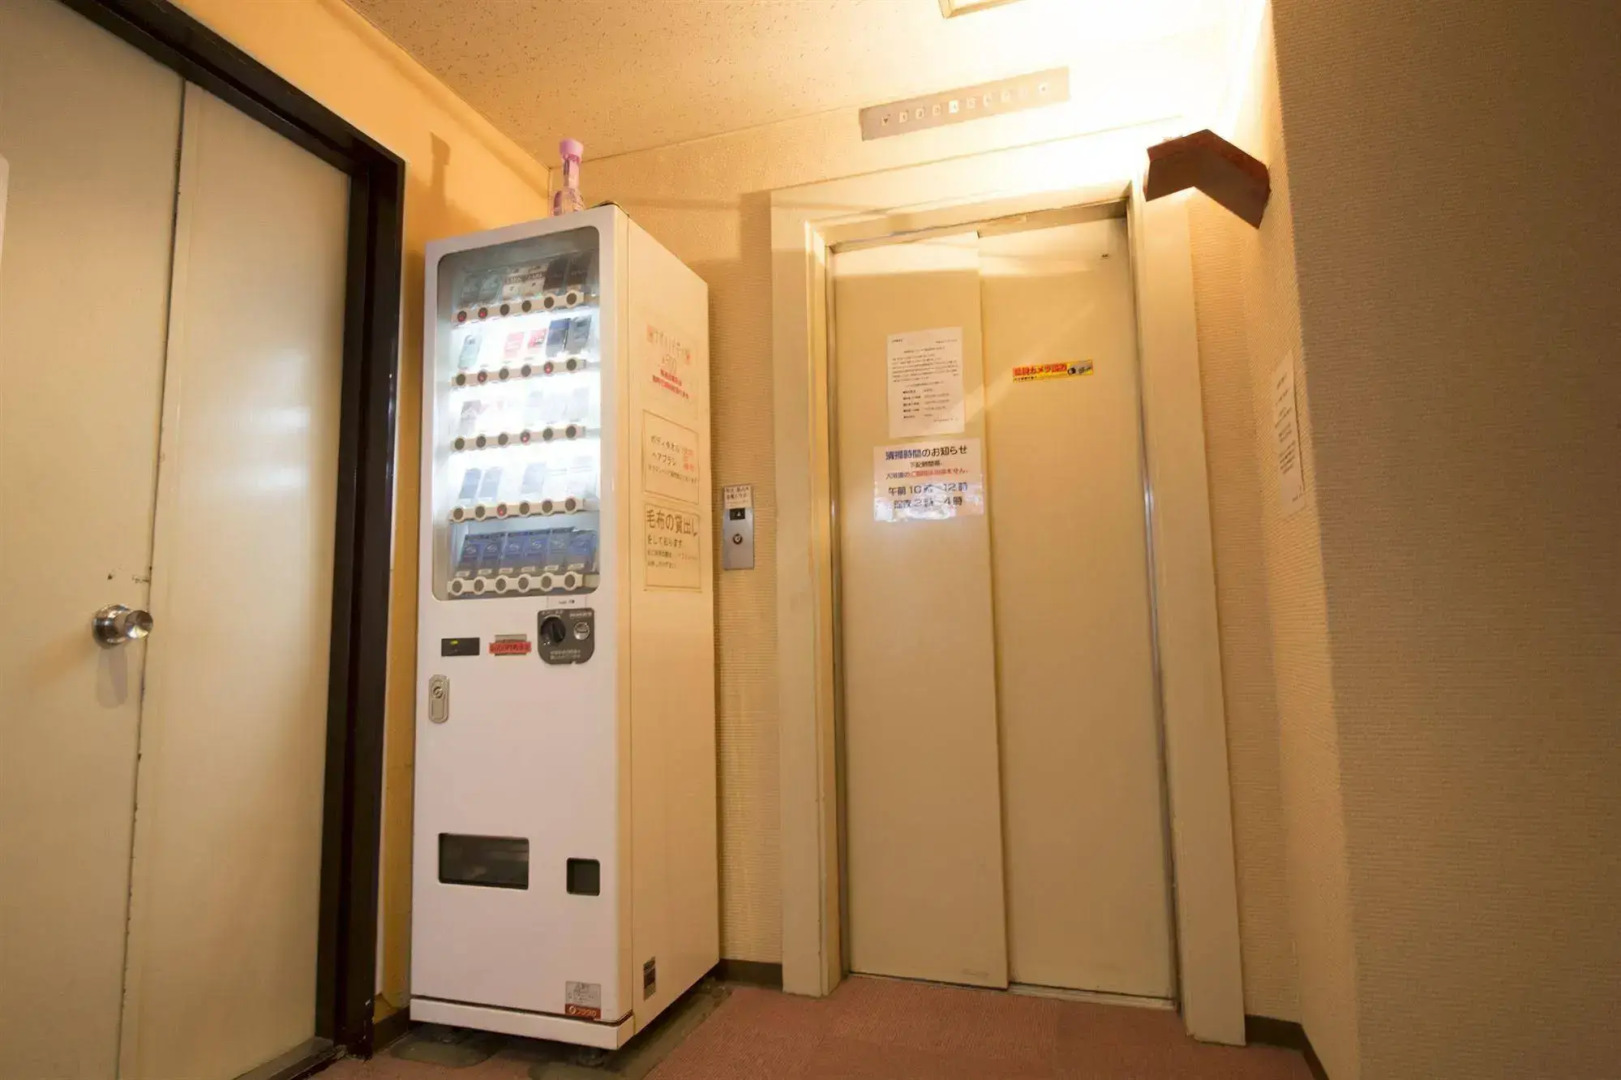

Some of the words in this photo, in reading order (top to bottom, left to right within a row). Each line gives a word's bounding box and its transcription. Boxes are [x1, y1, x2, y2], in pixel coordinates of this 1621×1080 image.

[885, 444, 968, 460] 清掃時間のお知らせ
[647, 509, 698, 537] 毛布の貸出し
